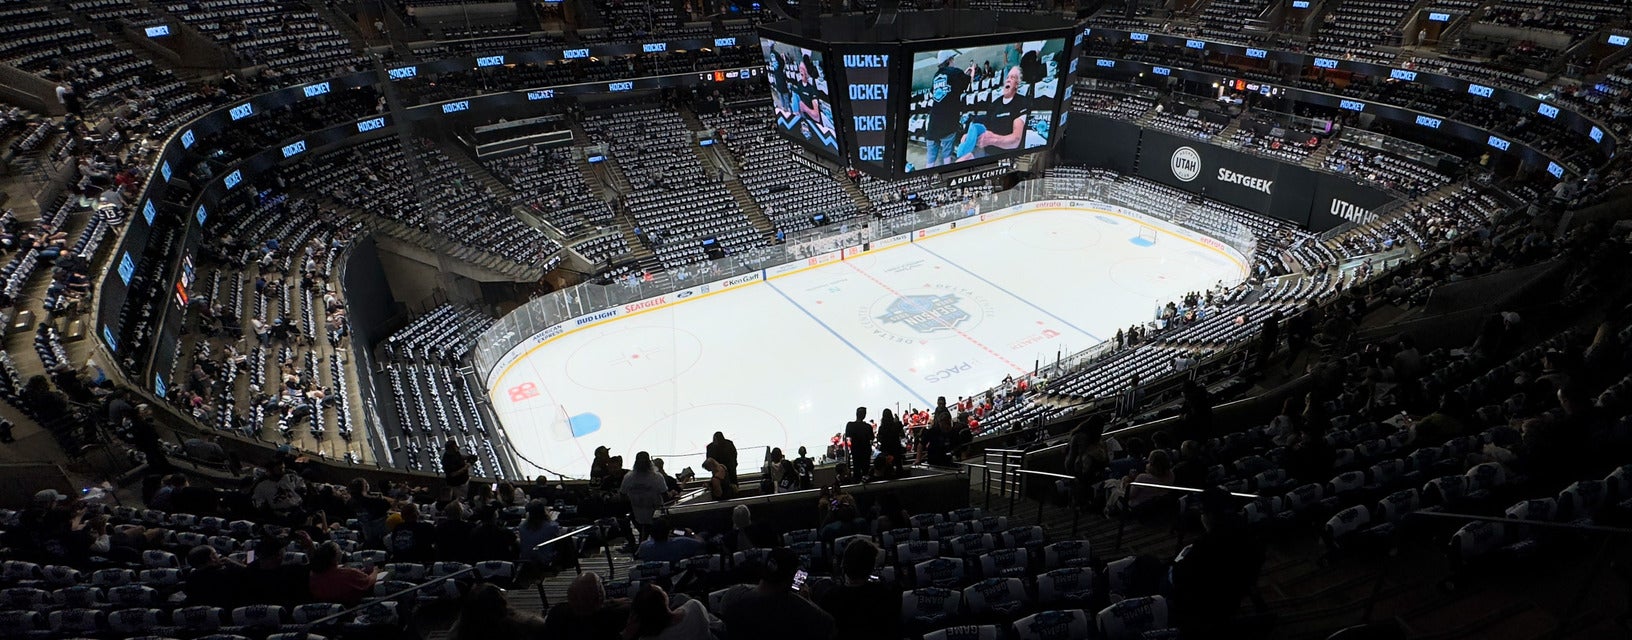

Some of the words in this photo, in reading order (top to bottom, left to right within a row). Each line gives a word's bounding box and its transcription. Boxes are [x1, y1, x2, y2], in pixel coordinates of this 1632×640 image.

[643, 42, 667, 53] HOCKEY
[714, 37, 736, 48] HOCKEY
[563, 48, 589, 59] HOCKEY
[477, 55, 505, 68] HOCKEY
[1313, 57, 1339, 69] HOCKEY
[1390, 68, 1418, 82] HOCKEY
[303, 81, 331, 98] HOCKEY
[608, 81, 633, 93] HOCKEY
[848, 84, 889, 100] OCKEY
[1467, 83, 1495, 98] HOCKEY
[442, 100, 469, 114] HOCKEY
[1339, 99, 1366, 112] HOCKEY
[357, 116, 385, 133] HOCKEY
[1415, 114, 1442, 129] HOCKEY
[1175, 156, 1197, 173] UTAH
[957, 173, 981, 184] DELTA
[981, 168, 1007, 179] CENTER
[1217, 167, 1273, 195] SEATGEEK
[1035, 201, 1062, 209] entrata
[1330, 198, 1364, 225] UTAH
[104, 209, 116, 219] 13
[728, 278, 743, 286] Ken
[624, 297, 667, 314] SEATGEEK
[577, 315, 594, 325] BUD
[594, 310, 617, 320] LIGHT
[924, 361, 972, 384] PACS
[945, 625, 979, 636] GAME
